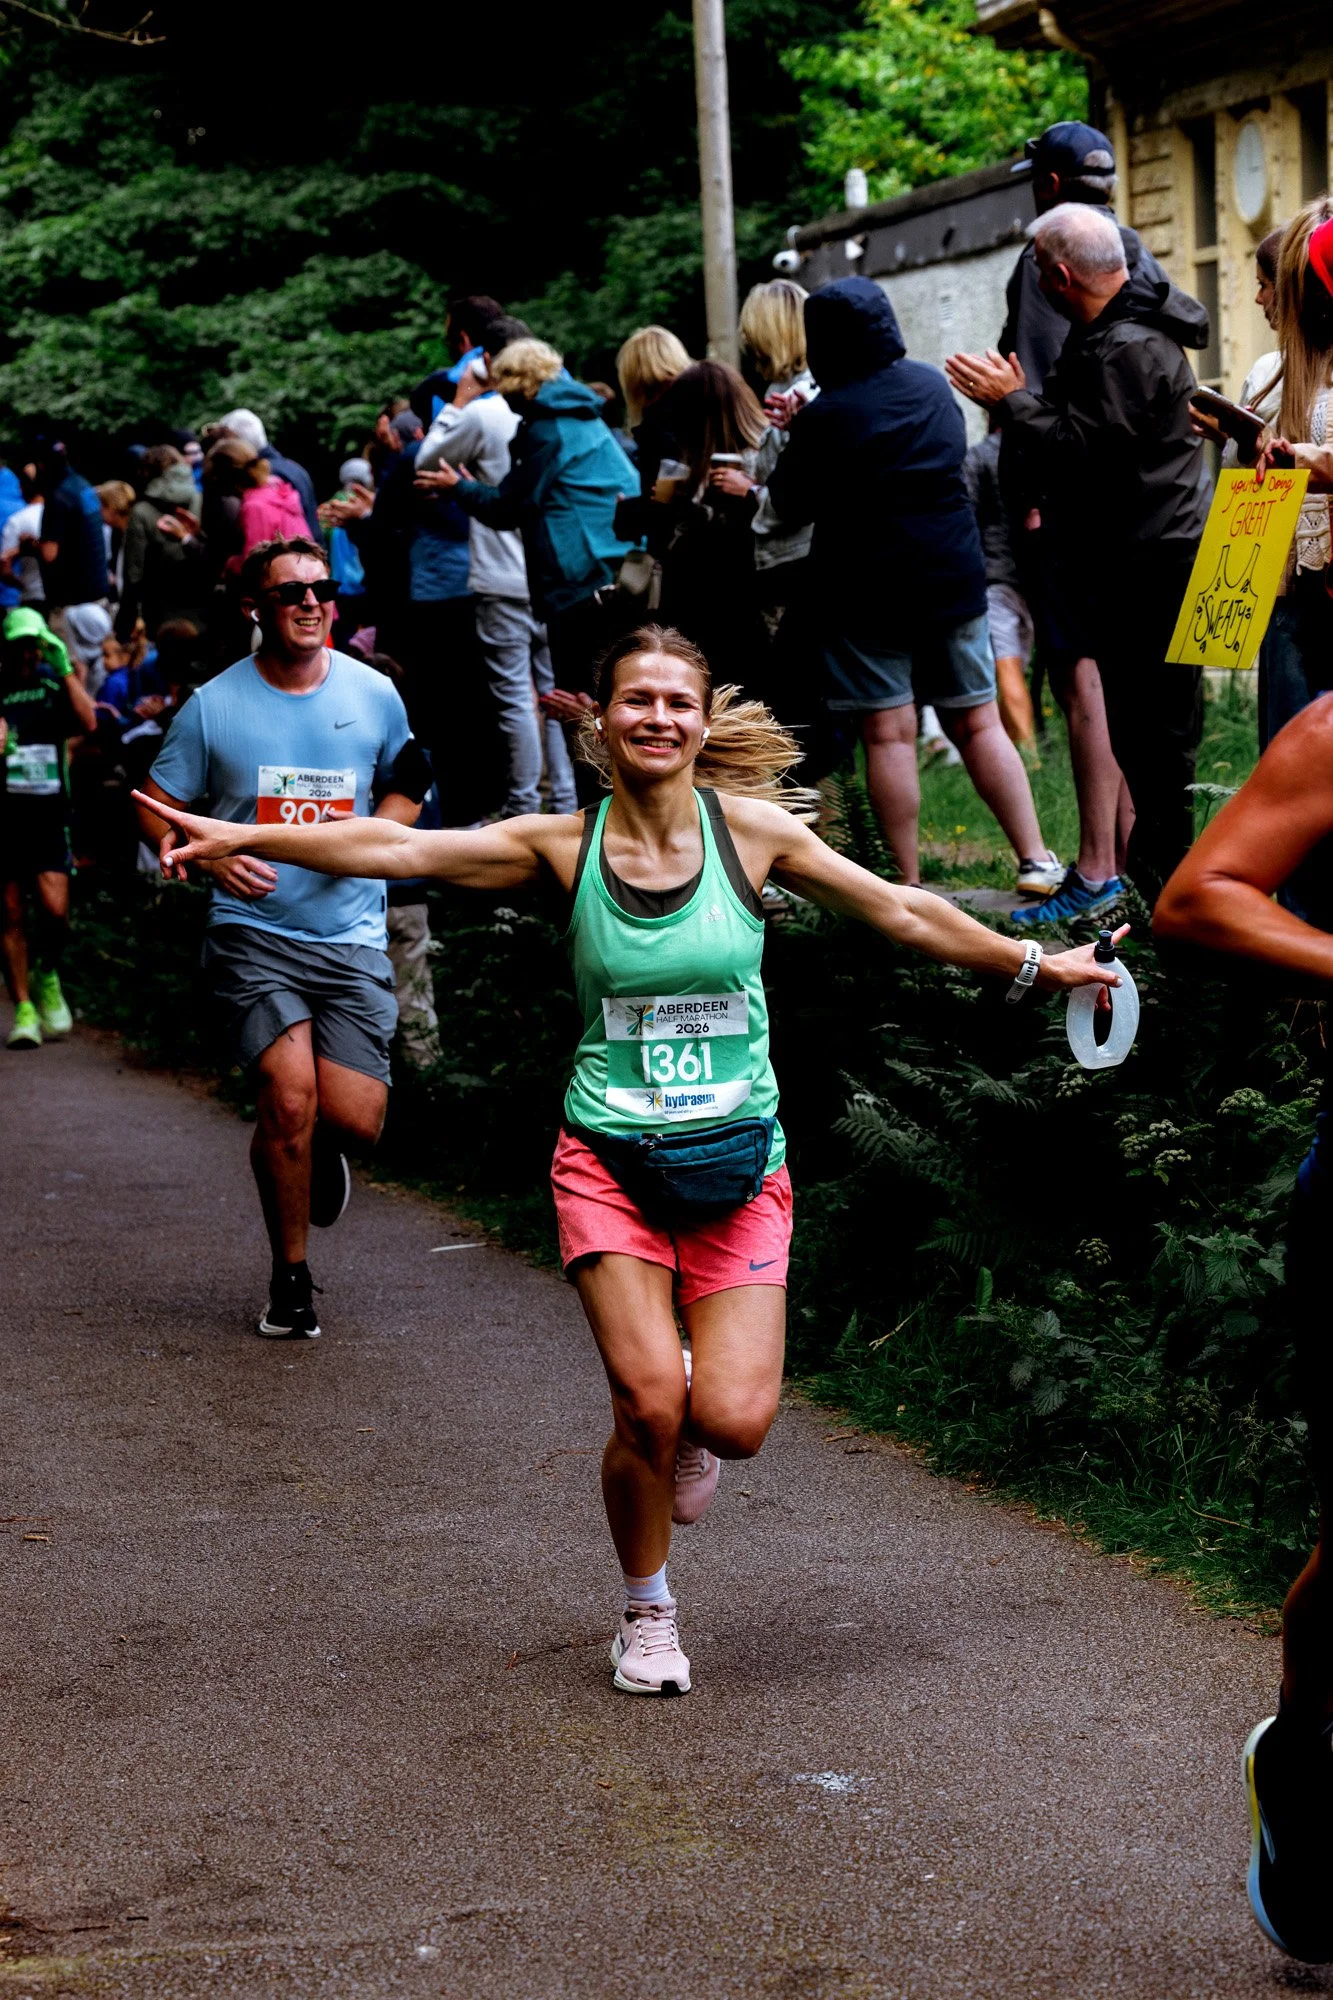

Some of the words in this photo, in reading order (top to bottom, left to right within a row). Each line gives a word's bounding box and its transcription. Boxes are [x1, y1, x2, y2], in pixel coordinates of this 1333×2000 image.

[1230, 500, 1277, 537] GREAT
[297, 774, 344, 783] ABERDEEN
[309, 789, 332, 797] 2026
[656, 1001, 729, 1015] ABERDEEN
[656, 1015, 679, 1023] HALF
[680, 1012, 729, 1022] MARATHON
[675, 1022, 710, 1034] 2026
[640, 1042, 713, 1084] 1361
[664, 1092, 716, 1109] hydrasun
